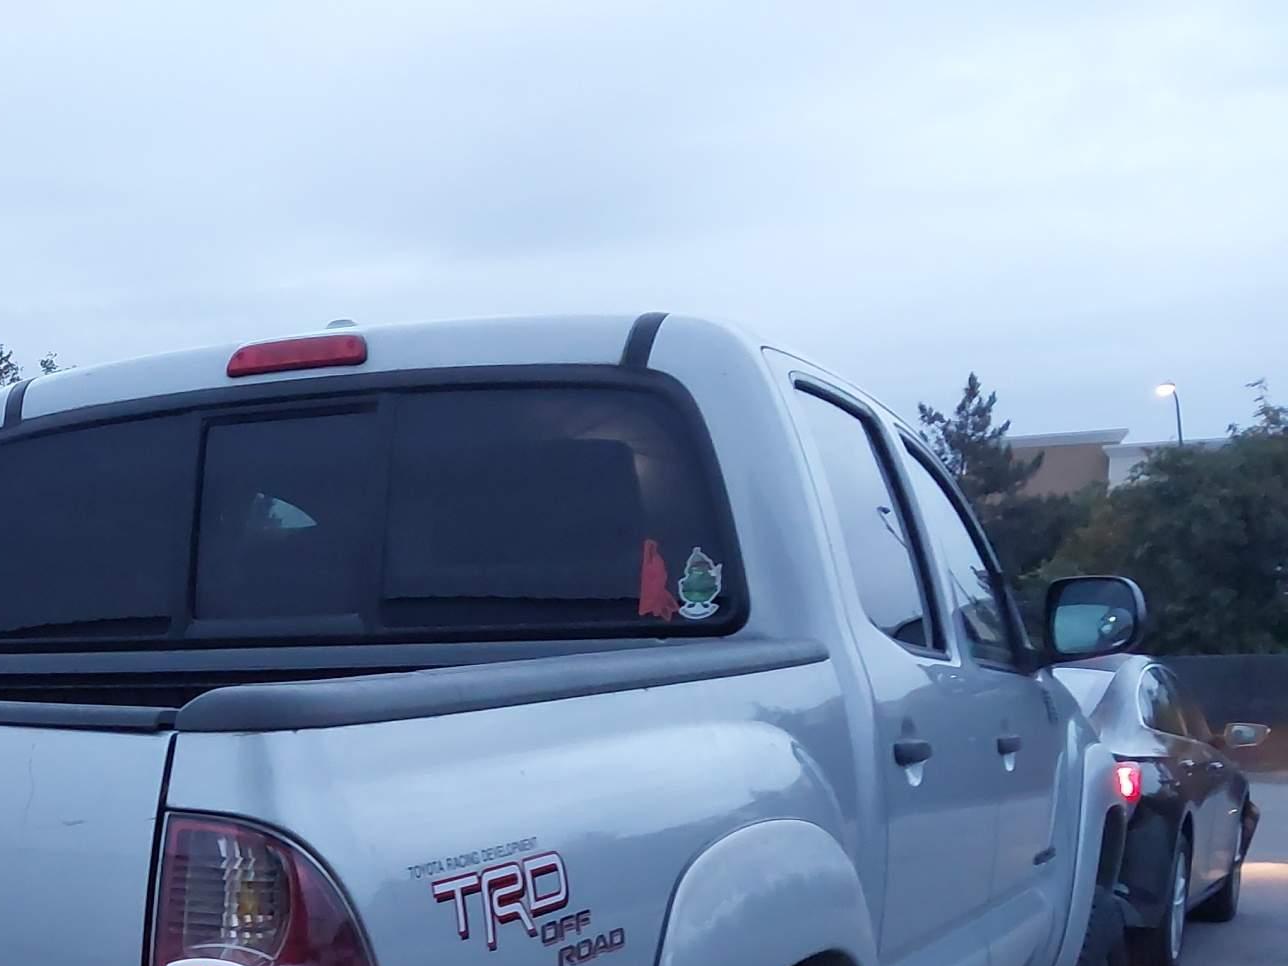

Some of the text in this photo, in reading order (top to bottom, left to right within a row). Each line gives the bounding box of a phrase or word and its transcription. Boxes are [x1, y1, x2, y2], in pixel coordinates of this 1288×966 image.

[408, 859, 444, 880] TOYOTA
[446, 850, 480, 873] RACING
[431, 850, 569, 951] TRD
[541, 908, 591, 945] OFF
